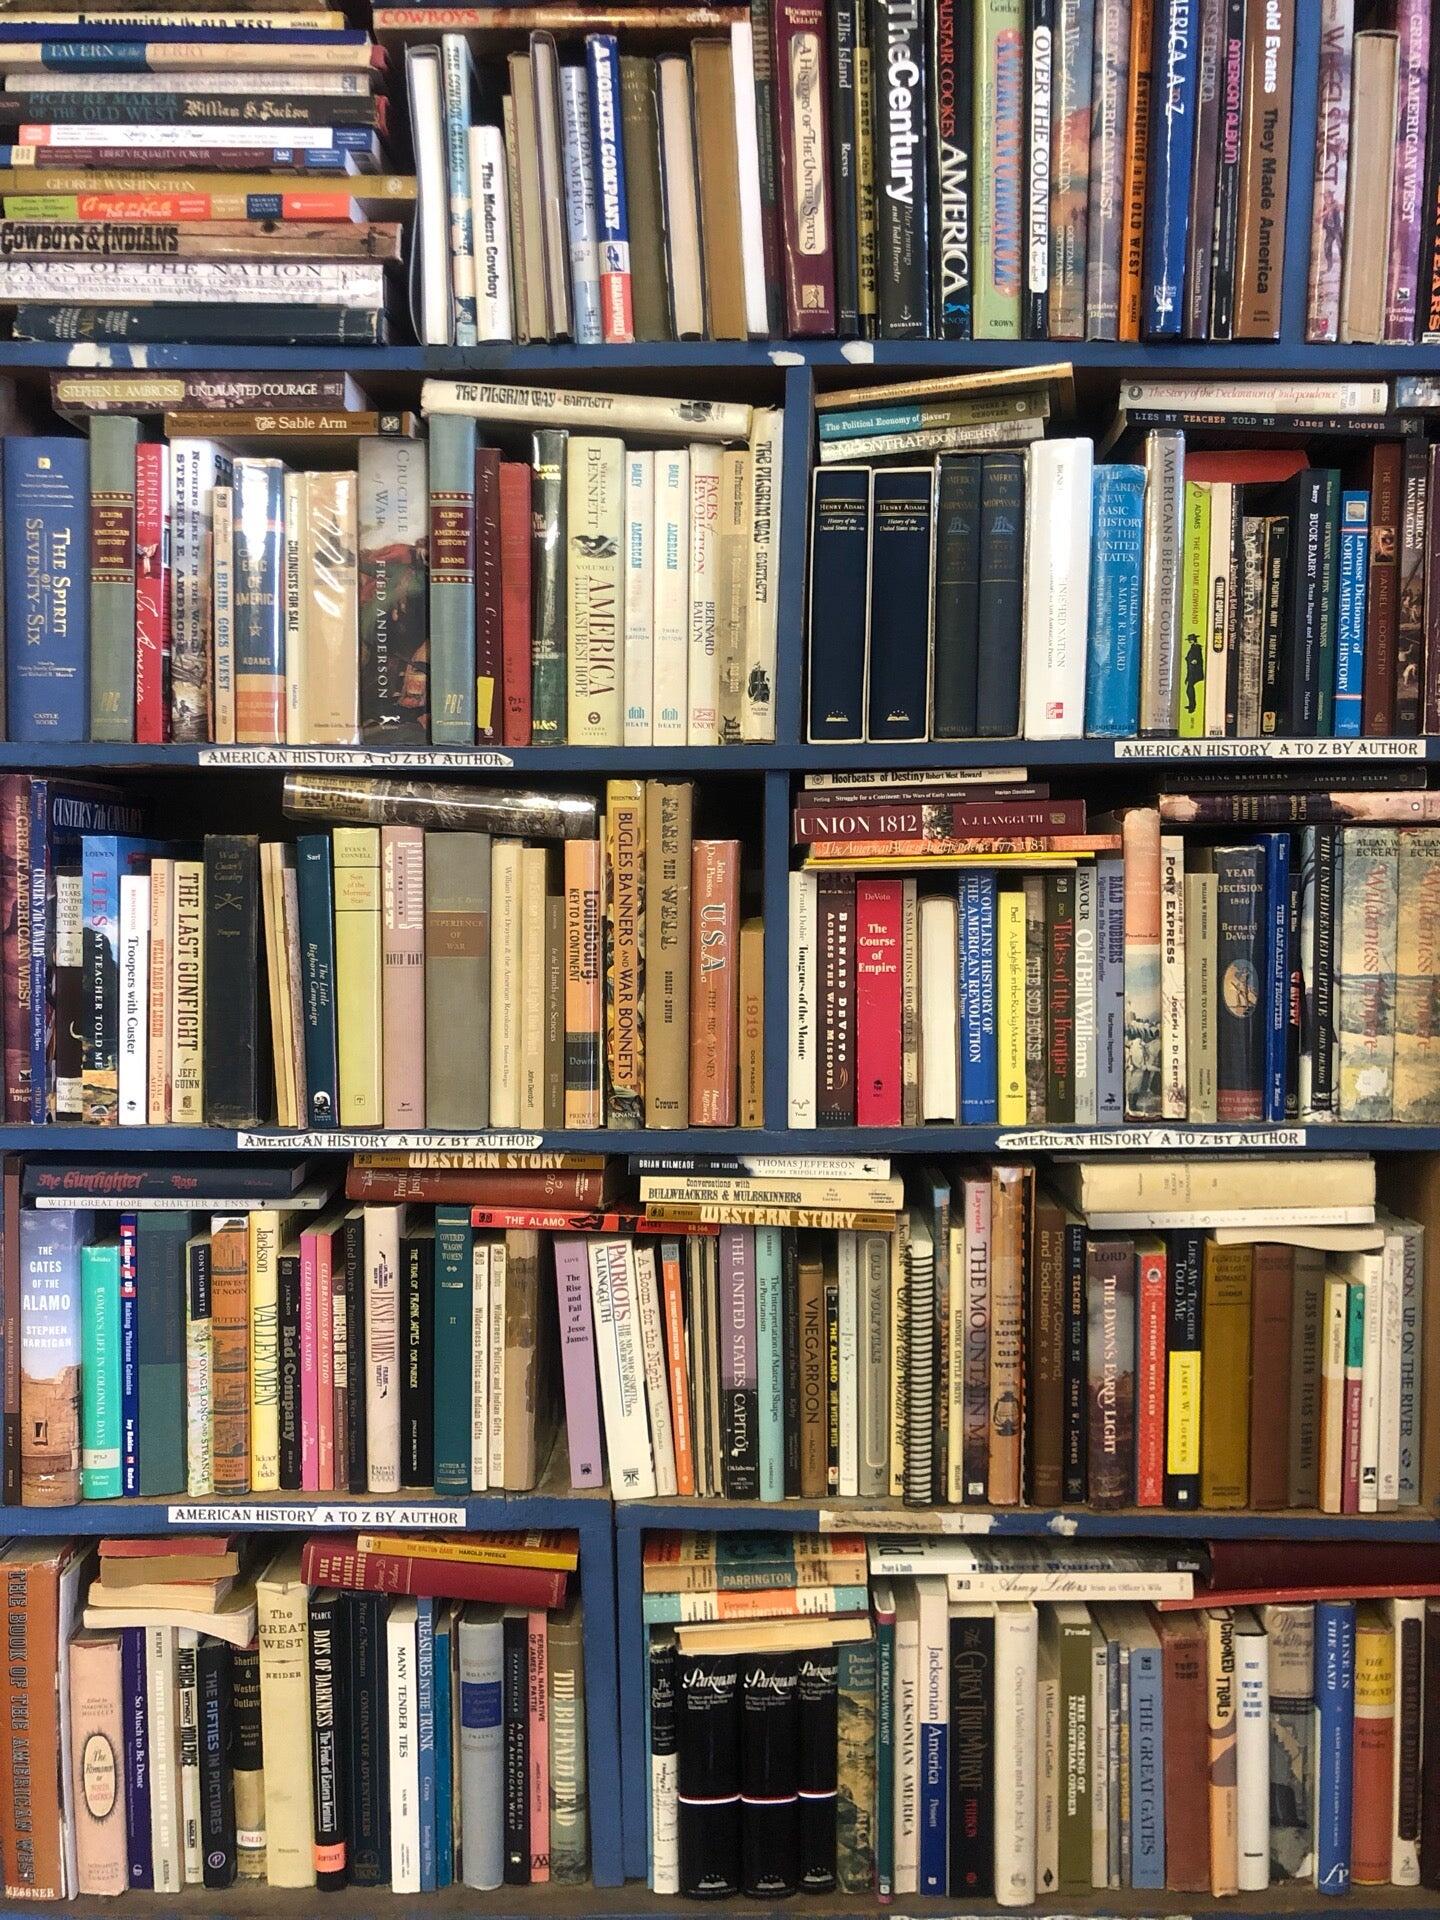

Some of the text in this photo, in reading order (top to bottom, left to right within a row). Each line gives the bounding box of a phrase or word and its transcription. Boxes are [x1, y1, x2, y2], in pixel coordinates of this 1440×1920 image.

[838, 11, 852, 177] Ellis Island Reeves
[1264, 36, 1279, 93] Evans
[1402, 16, 1422, 222] GREAT AMERICAN WEST
[1034, 36, 1049, 245] OVER THE COUNTER
[481, 163, 499, 298] The Modern Cowboy
[892, 206, 900, 222] and
[893, 225, 901, 244] Todd
[902, 228, 914, 266] Jennings
[942, 140, 967, 297] AMERICA
[1257, 109, 1277, 293] They Made America
[52, 528, 71, 636] THE SPIRIT
[1159, 446, 1175, 696] AMERICANS BEFORE COLUMBUS
[1338, 535, 1352, 691] NORTH AMERICAN HISTORY
[1351, 535, 1365, 655] Larousse Dictionary of
[375, 560, 388, 699] FRED ANDERSON
[589, 576, 614, 695] AMERICA
[693, 601, 715, 656] BERNARD BAILYN
[208, 750, 502, 766] AMERICAN HISTORY A TO Z BY AUTHOR
[1122, 742, 1416, 757] AMERICAN HISTORY A TO Z BY AUTHOR
[799, 815, 873, 836] UNION
[878, 814, 916, 833] 1812
[983, 814, 1044, 825] LANGGUTH
[1320, 835, 1329, 862] THE
[178, 873, 199, 1050] THE LAST GUNFIGHT
[981, 876, 993, 1034] AN OUTLINE HISTORY OF
[1318, 866, 1329, 958] UNREDEEMED
[91, 871, 107, 1068] LIES MY TEACHER TOLD ME
[125, 936, 138, 1054] Troopers with Custer
[747, 994, 758, 1038] 1919
[968, 876, 981, 1063] THE AMERICAN REVOLUTION
[1317, 960, 1328, 1017] CAPTIVE
[1004, 1133, 1298, 1147] AMERICAN HISTORY A TO Z BY AUTHOR
[504, 1216, 565, 1226] THE ALAMO
[197, 1248, 206, 1311] TONY HORWITZ
[253, 1226, 276, 1404] Jackson VALLEY MEN
[608, 1244, 631, 1321] PATRIOTS
[970, 1242, 986, 1417] THE MOUNTAIN
[1175, 1260, 1186, 1320] TOLD ME
[1185, 1240, 1197, 1341] LIES MY TEACHER
[733, 1234, 747, 1454] THE UNITED STATES CAPITOL
[805, 1298, 819, 1423] VINEGARROON
[1098, 1276, 1116, 1454] THE DAWN'S EARLY LIGHT
[1401, 1235, 1416, 1436] MADSON UP ON THE RIVER
[175, 1509, 458, 1522] AMERICAN HISTORY A TO Z BY AUTHOR
[259, 1609, 307, 1647] The GREAT WEST
[418, 1613, 433, 1751] TREASURES IN THE TRUNK
[1327, 1619, 1336, 1690] THE SAND
[1342, 1620, 1350, 1688] A LINE IN
[8, 1570, 35, 1885] THE BOOK OF THE AMERICAN WEST
[207, 1700, 219, 1750] FIFTIES
[396, 1647, 408, 1758] MANY TENDER TIES
[926, 1647, 941, 1720] Jacksonian
[135, 1696, 145, 1788] So Much to Be Done
[900, 1679, 914, 1836] JACKSONIAN AMERICA
[927, 1725, 941, 1784] America
[1139, 1694, 1156, 1855] THE GREAT GATES
